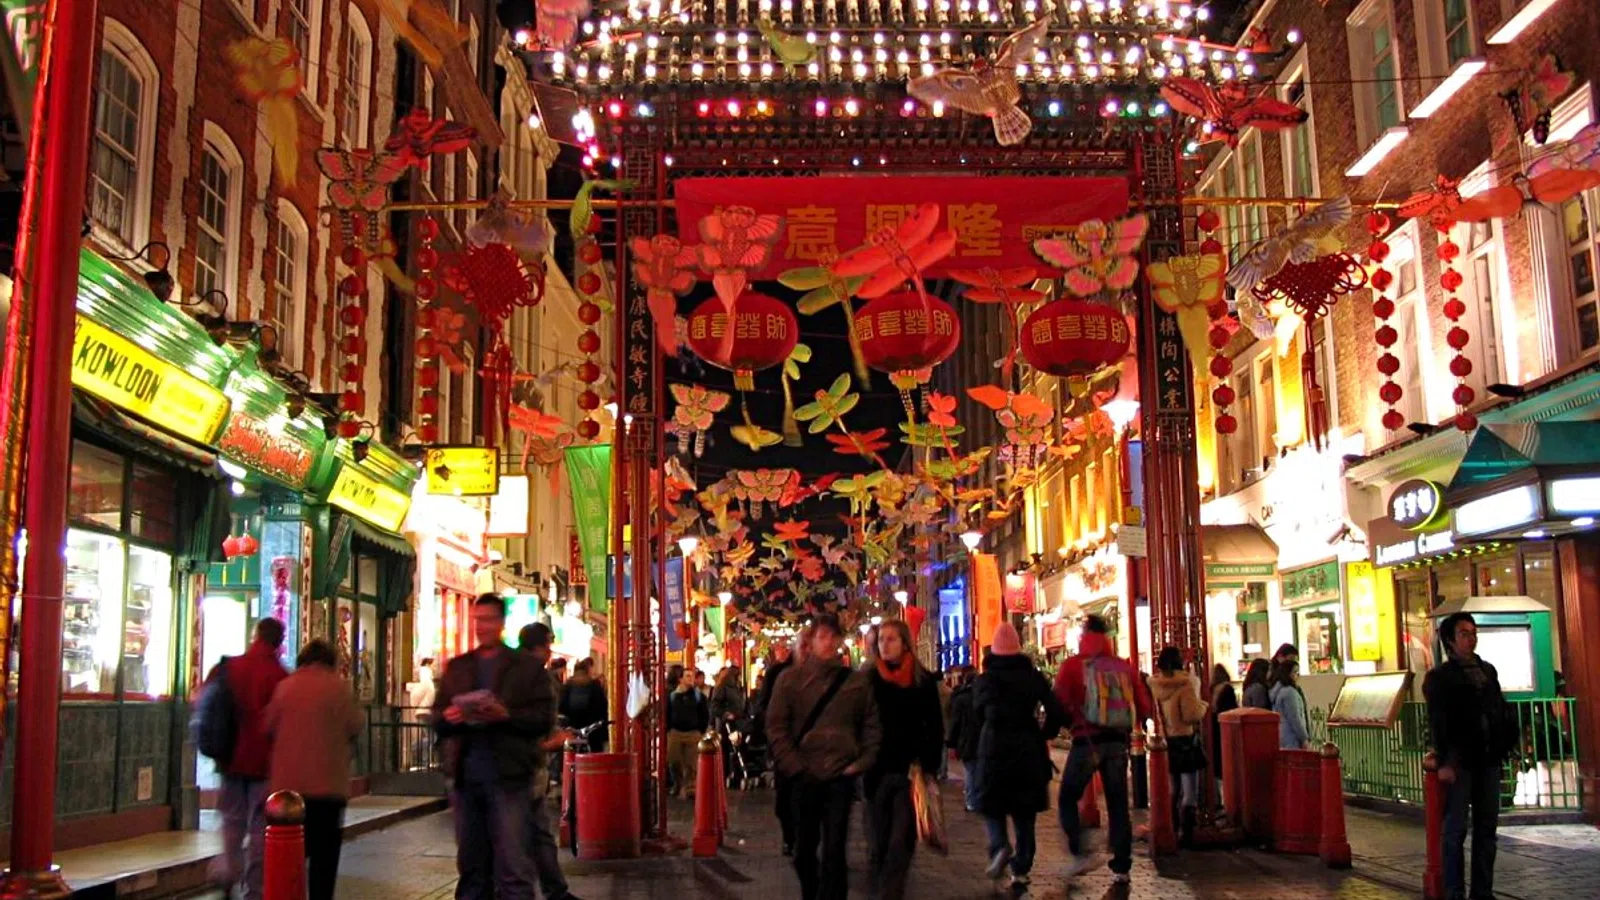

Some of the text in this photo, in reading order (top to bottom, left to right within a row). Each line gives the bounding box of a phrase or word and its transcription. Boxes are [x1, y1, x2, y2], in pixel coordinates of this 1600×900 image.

[712, 203, 1003, 259] 意興隆
[75, 335, 164, 405] KOWLOON
